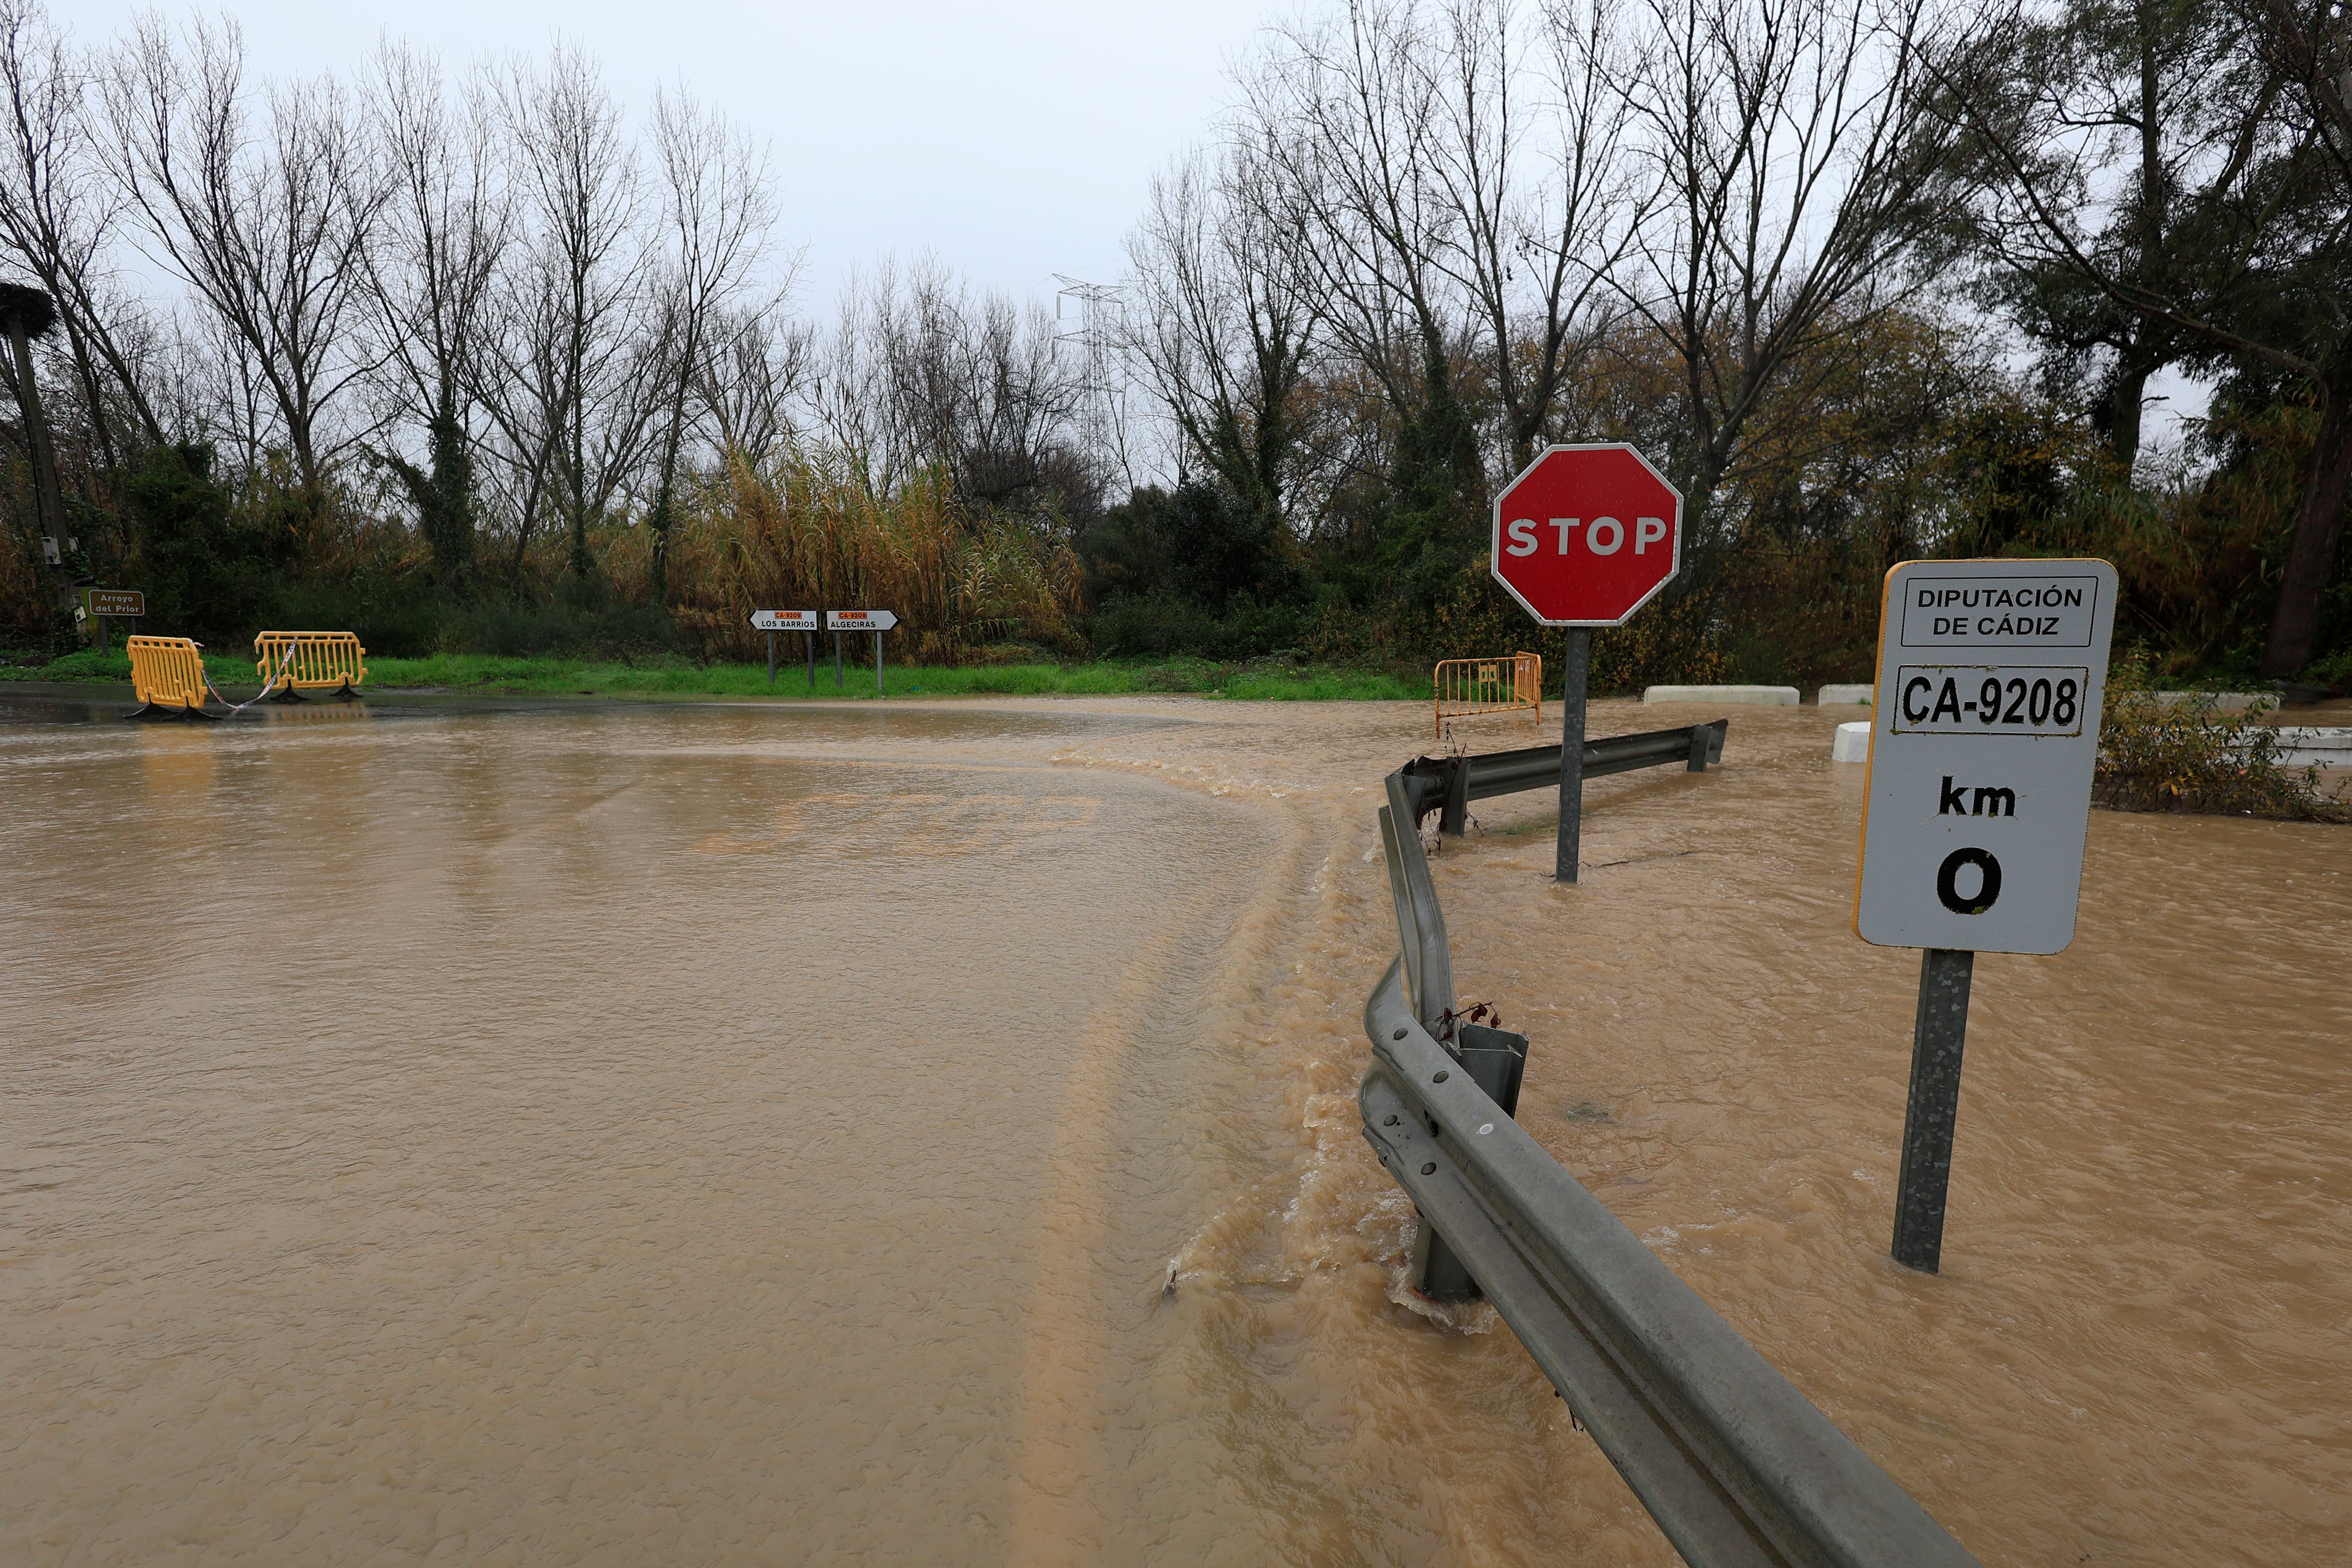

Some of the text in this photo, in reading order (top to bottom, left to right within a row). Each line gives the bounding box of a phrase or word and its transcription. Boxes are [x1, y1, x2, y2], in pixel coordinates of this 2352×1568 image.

[1506, 516, 1667, 557] STOP
[1918, 585, 2082, 607] DIPUTACIÓN
[1933, 613, 2060, 635] DE CÁDIZ
[1903, 676, 2077, 725] CA-9208
[1939, 775, 2016, 817] km
